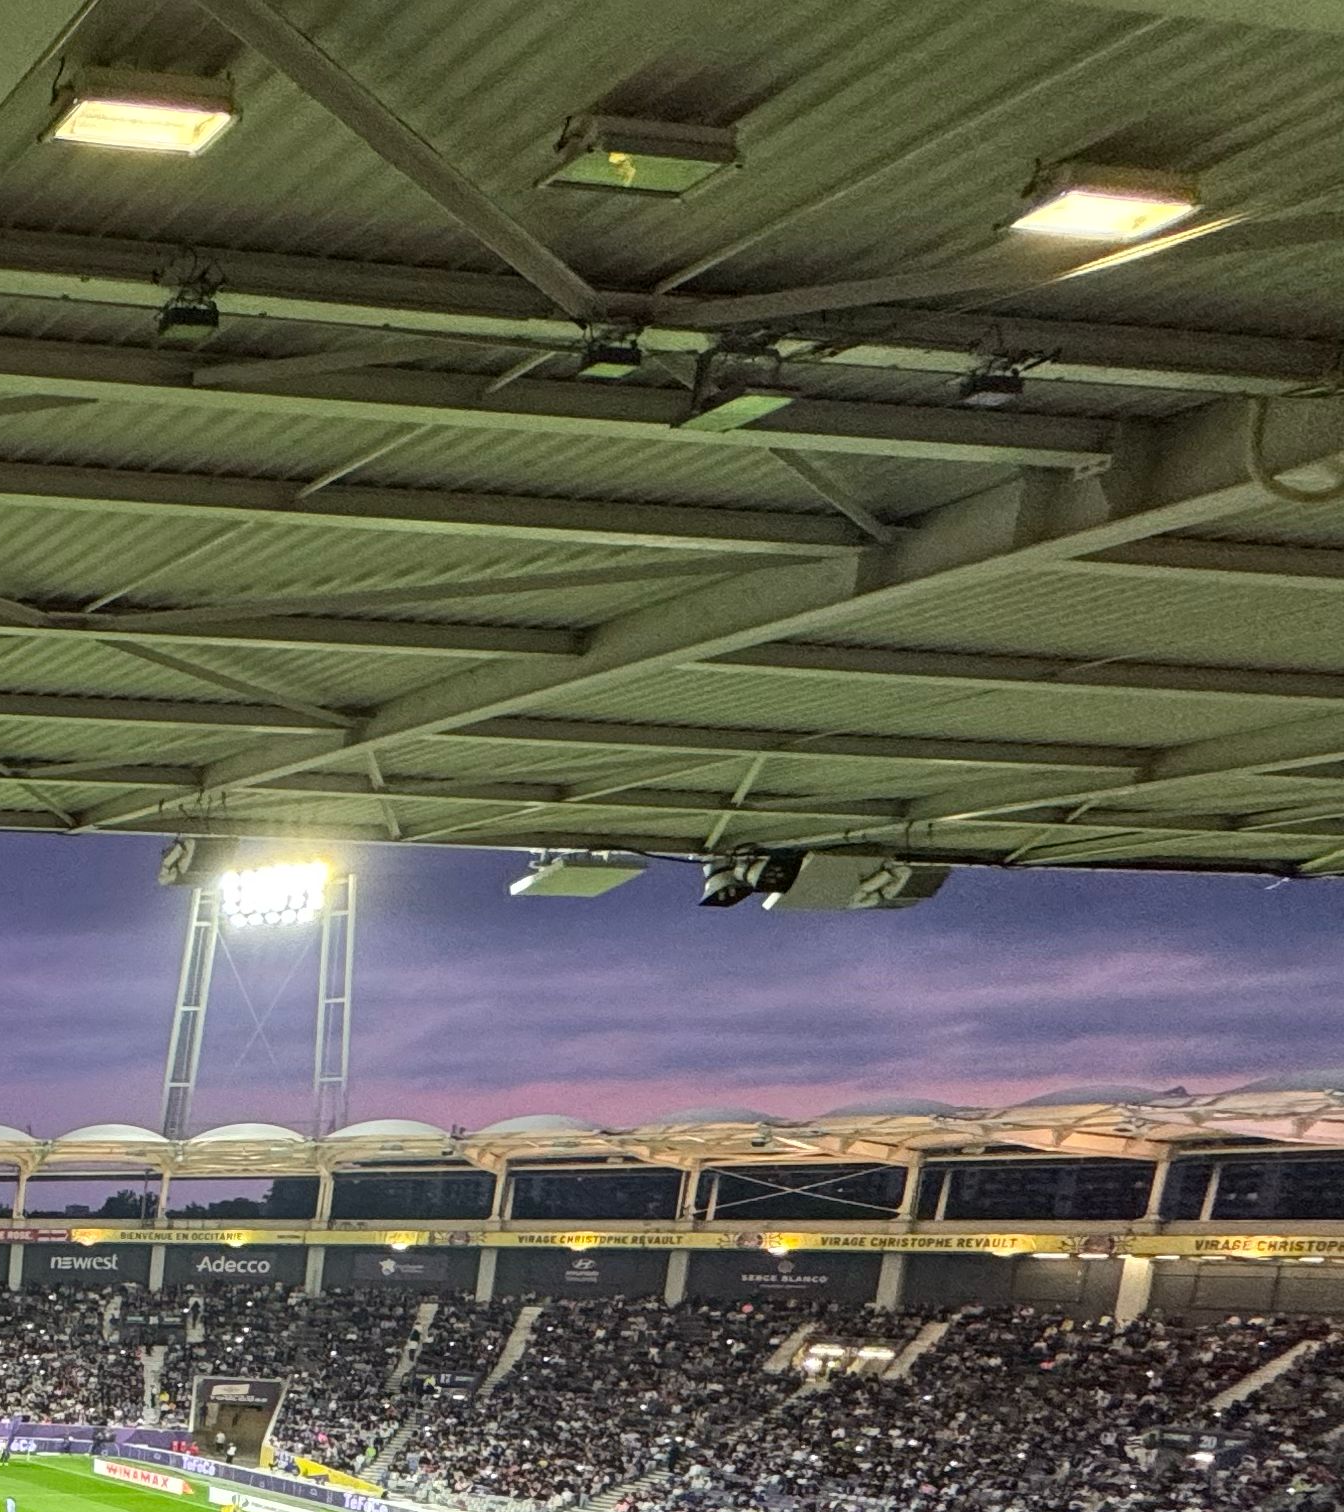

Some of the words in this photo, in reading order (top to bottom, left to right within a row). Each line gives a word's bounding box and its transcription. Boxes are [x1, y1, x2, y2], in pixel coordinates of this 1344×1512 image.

[7, 1230, 32, 1240] ROSE
[120, 1230, 174, 1241] BIENVENUE
[176, 1230, 189, 1241] EN
[191, 1230, 243, 1241] OCCITANIE
[517, 1234, 556, 1246] VIRAGE
[559, 1234, 628, 1246] CHRISTOPHE
[630, 1234, 683, 1246] REVAULT
[820, 1236, 867, 1248] VIRAGE
[870, 1236, 955, 1248] CHRISTOPHE
[958, 1236, 1018, 1249] REVAULT
[1195, 1239, 1251, 1251] VIRAGE
[196, 1255, 272, 1274] Adecco
[741, 1274, 777, 1283] SERGE
[780, 1274, 828, 1283] BLANCO
[106, 1461, 170, 1489] WINAMAX
